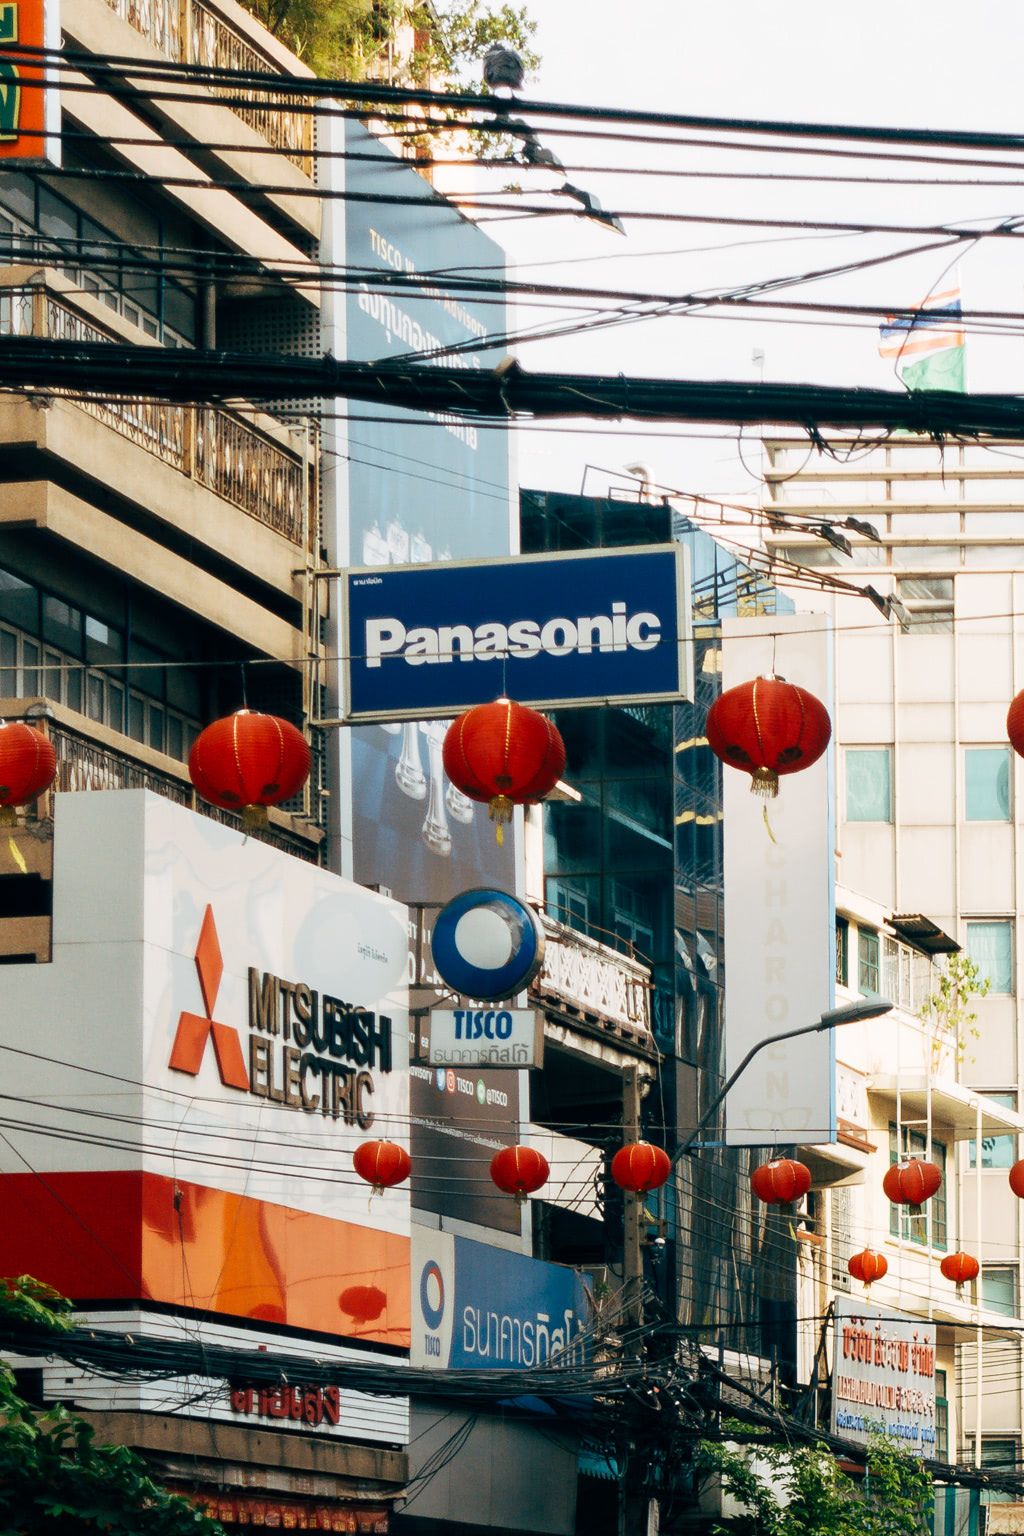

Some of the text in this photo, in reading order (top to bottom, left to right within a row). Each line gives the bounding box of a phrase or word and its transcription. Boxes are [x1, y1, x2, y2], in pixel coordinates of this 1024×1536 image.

[365, 601, 662, 668] Panasonic
[248, 966, 393, 1074] MITSUBISHI
[453, 1010, 513, 1040] TISCO
[433, 1043, 530, 1063] ธนาคารทิสโก้
[249, 1033, 375, 1131] ELECTRIC
[457, 1077, 474, 1096] TISCO
[486, 1088, 508, 1107] @TISCO
[424, 1334, 441, 1358] TISCO
